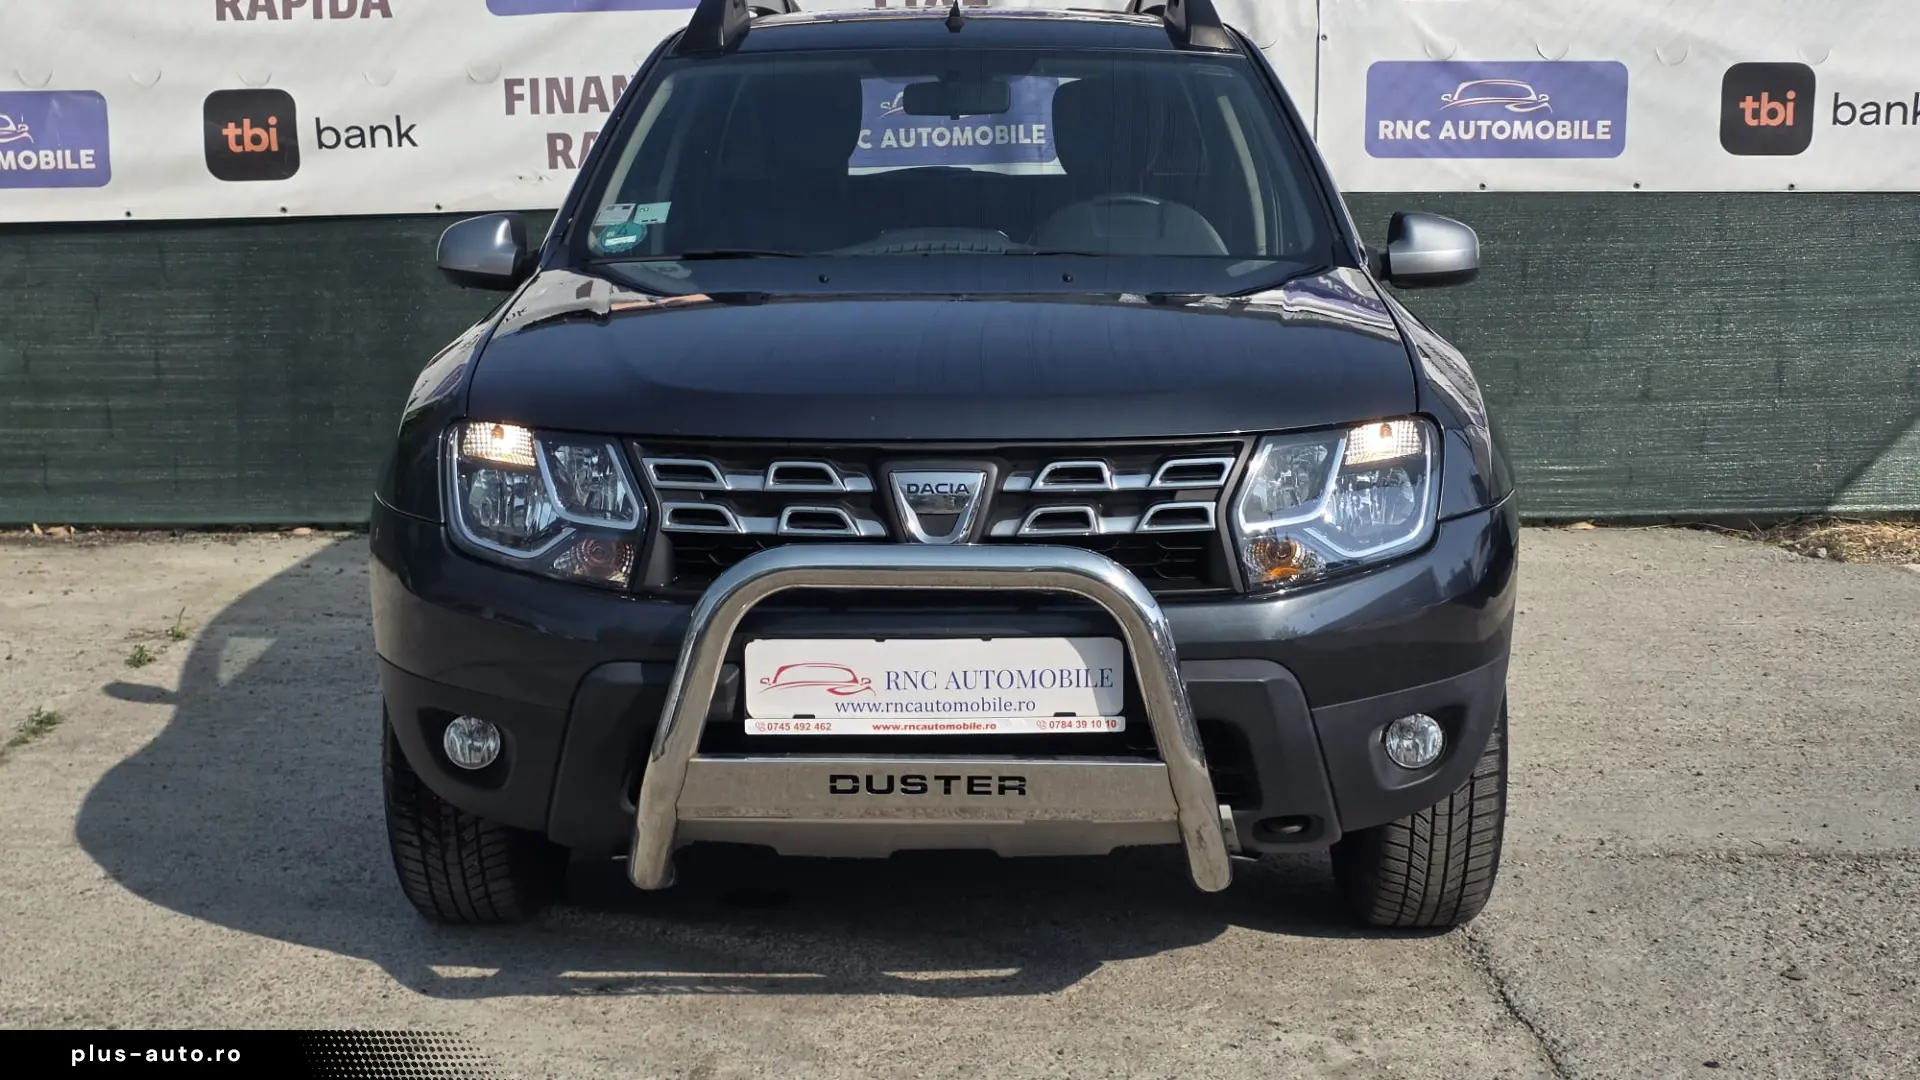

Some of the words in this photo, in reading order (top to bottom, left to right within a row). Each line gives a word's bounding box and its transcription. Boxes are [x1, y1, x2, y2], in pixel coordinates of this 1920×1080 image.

[1740, 91, 1795, 127] tbi
[223, 116, 279, 153] tbi
[315, 114, 418, 149] bank
[880, 123, 1046, 149] AUTOMOBILE
[1378, 119, 1431, 140] RNC
[1438, 119, 1612, 140] AUTOMOBILE
[906, 483, 970, 495] DACIA
[886, 669, 937, 691] RNC
[944, 667, 1114, 691] AUTOMOBILE
[834, 697, 1036, 714] www.rncautomobile.ro
[766, 722, 791, 731] 0745
[792, 722, 811, 731] 492
[813, 722, 832, 731] 462
[872, 722, 997, 731] www.rncautomobile.ro
[1048, 720, 1073, 730] 0784
[1074, 720, 1088, 729] 39
[1090, 719, 1103, 729] 10
[1105, 719, 1117, 729] 10
[829, 774, 1027, 796] DUSTER
